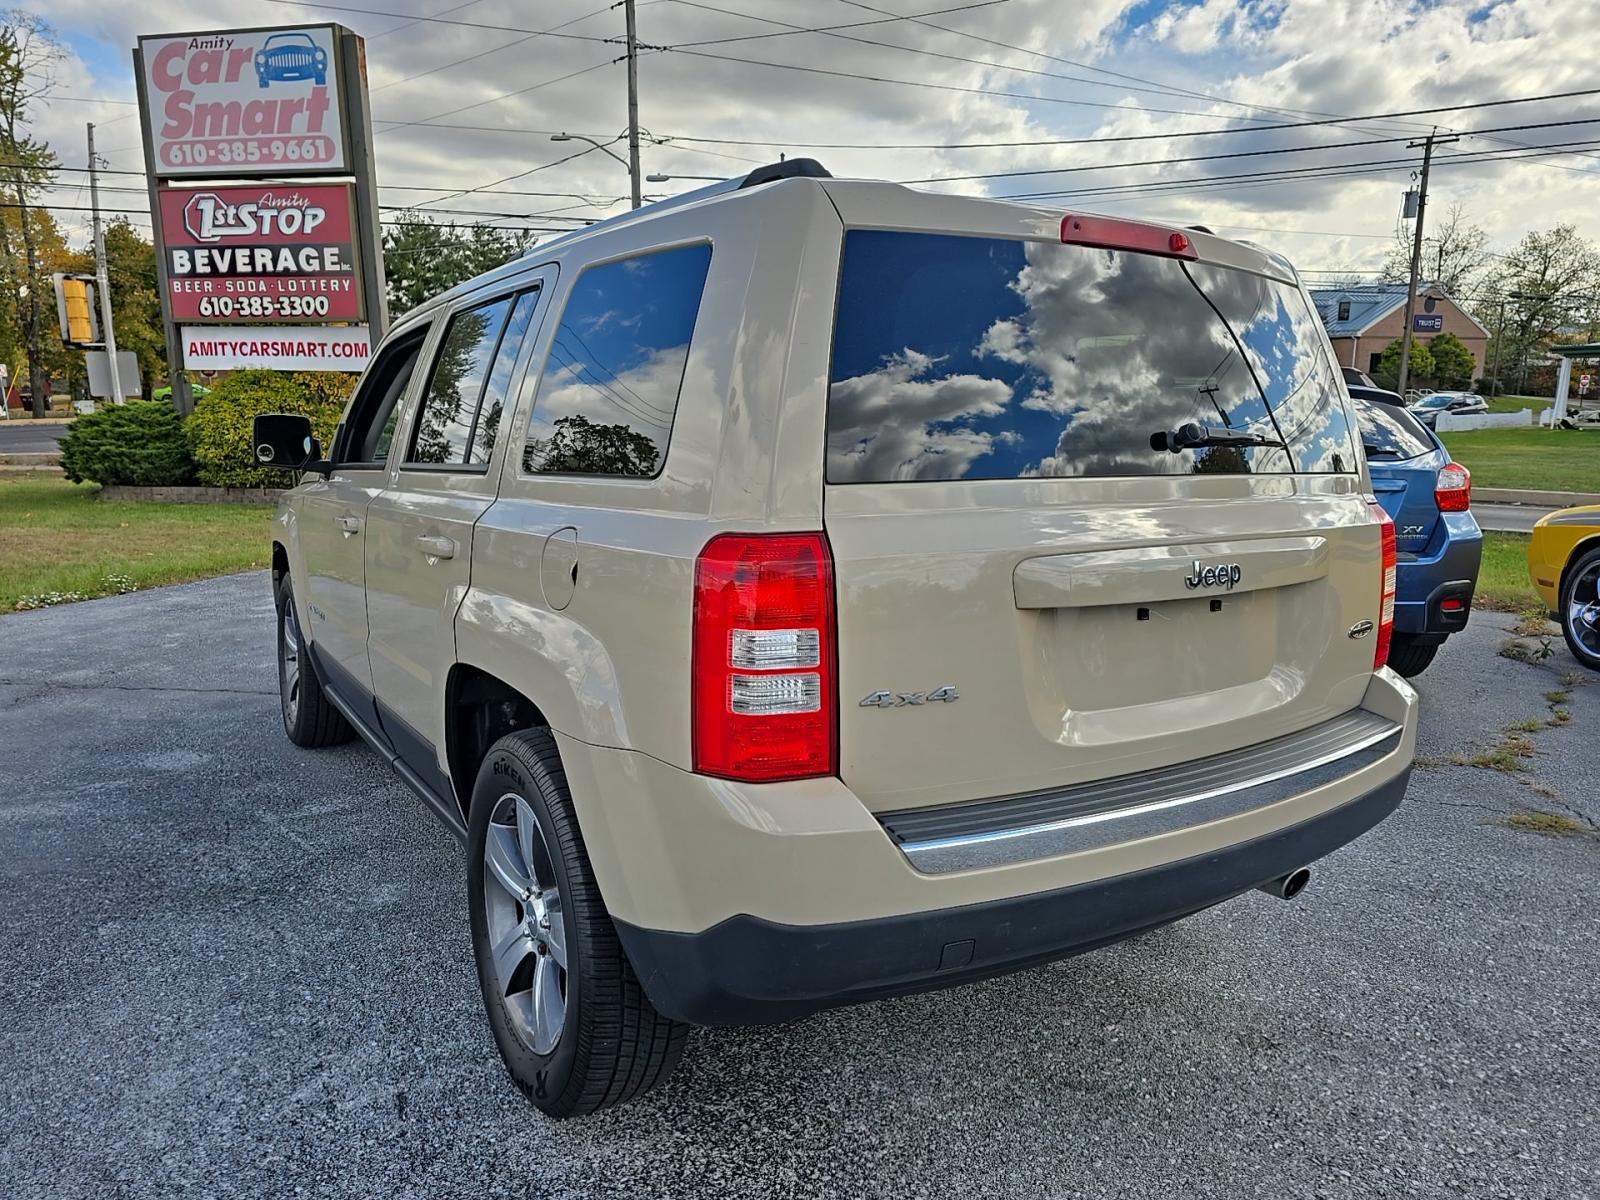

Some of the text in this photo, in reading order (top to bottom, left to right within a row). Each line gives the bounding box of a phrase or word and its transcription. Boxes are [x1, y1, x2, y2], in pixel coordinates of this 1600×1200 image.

[188, 35, 235, 51] Amity
[152, 42, 253, 92] Car
[160, 87, 330, 139] Smart
[169, 139, 327, 164] 610-385-9661
[258, 192, 310, 210] Amity
[172, 247, 341, 274] BEVERAGE
[173, 279, 351, 293] BEER SODA LOTTERY
[199, 295, 330, 317] 610-385-3300
[189, 341, 368, 358] AMITYCARSMART.COM
[1402, 525, 1424, 534] XV
[1185, 560, 1241, 590] Jeep
[859, 684, 960, 708] 4x4
